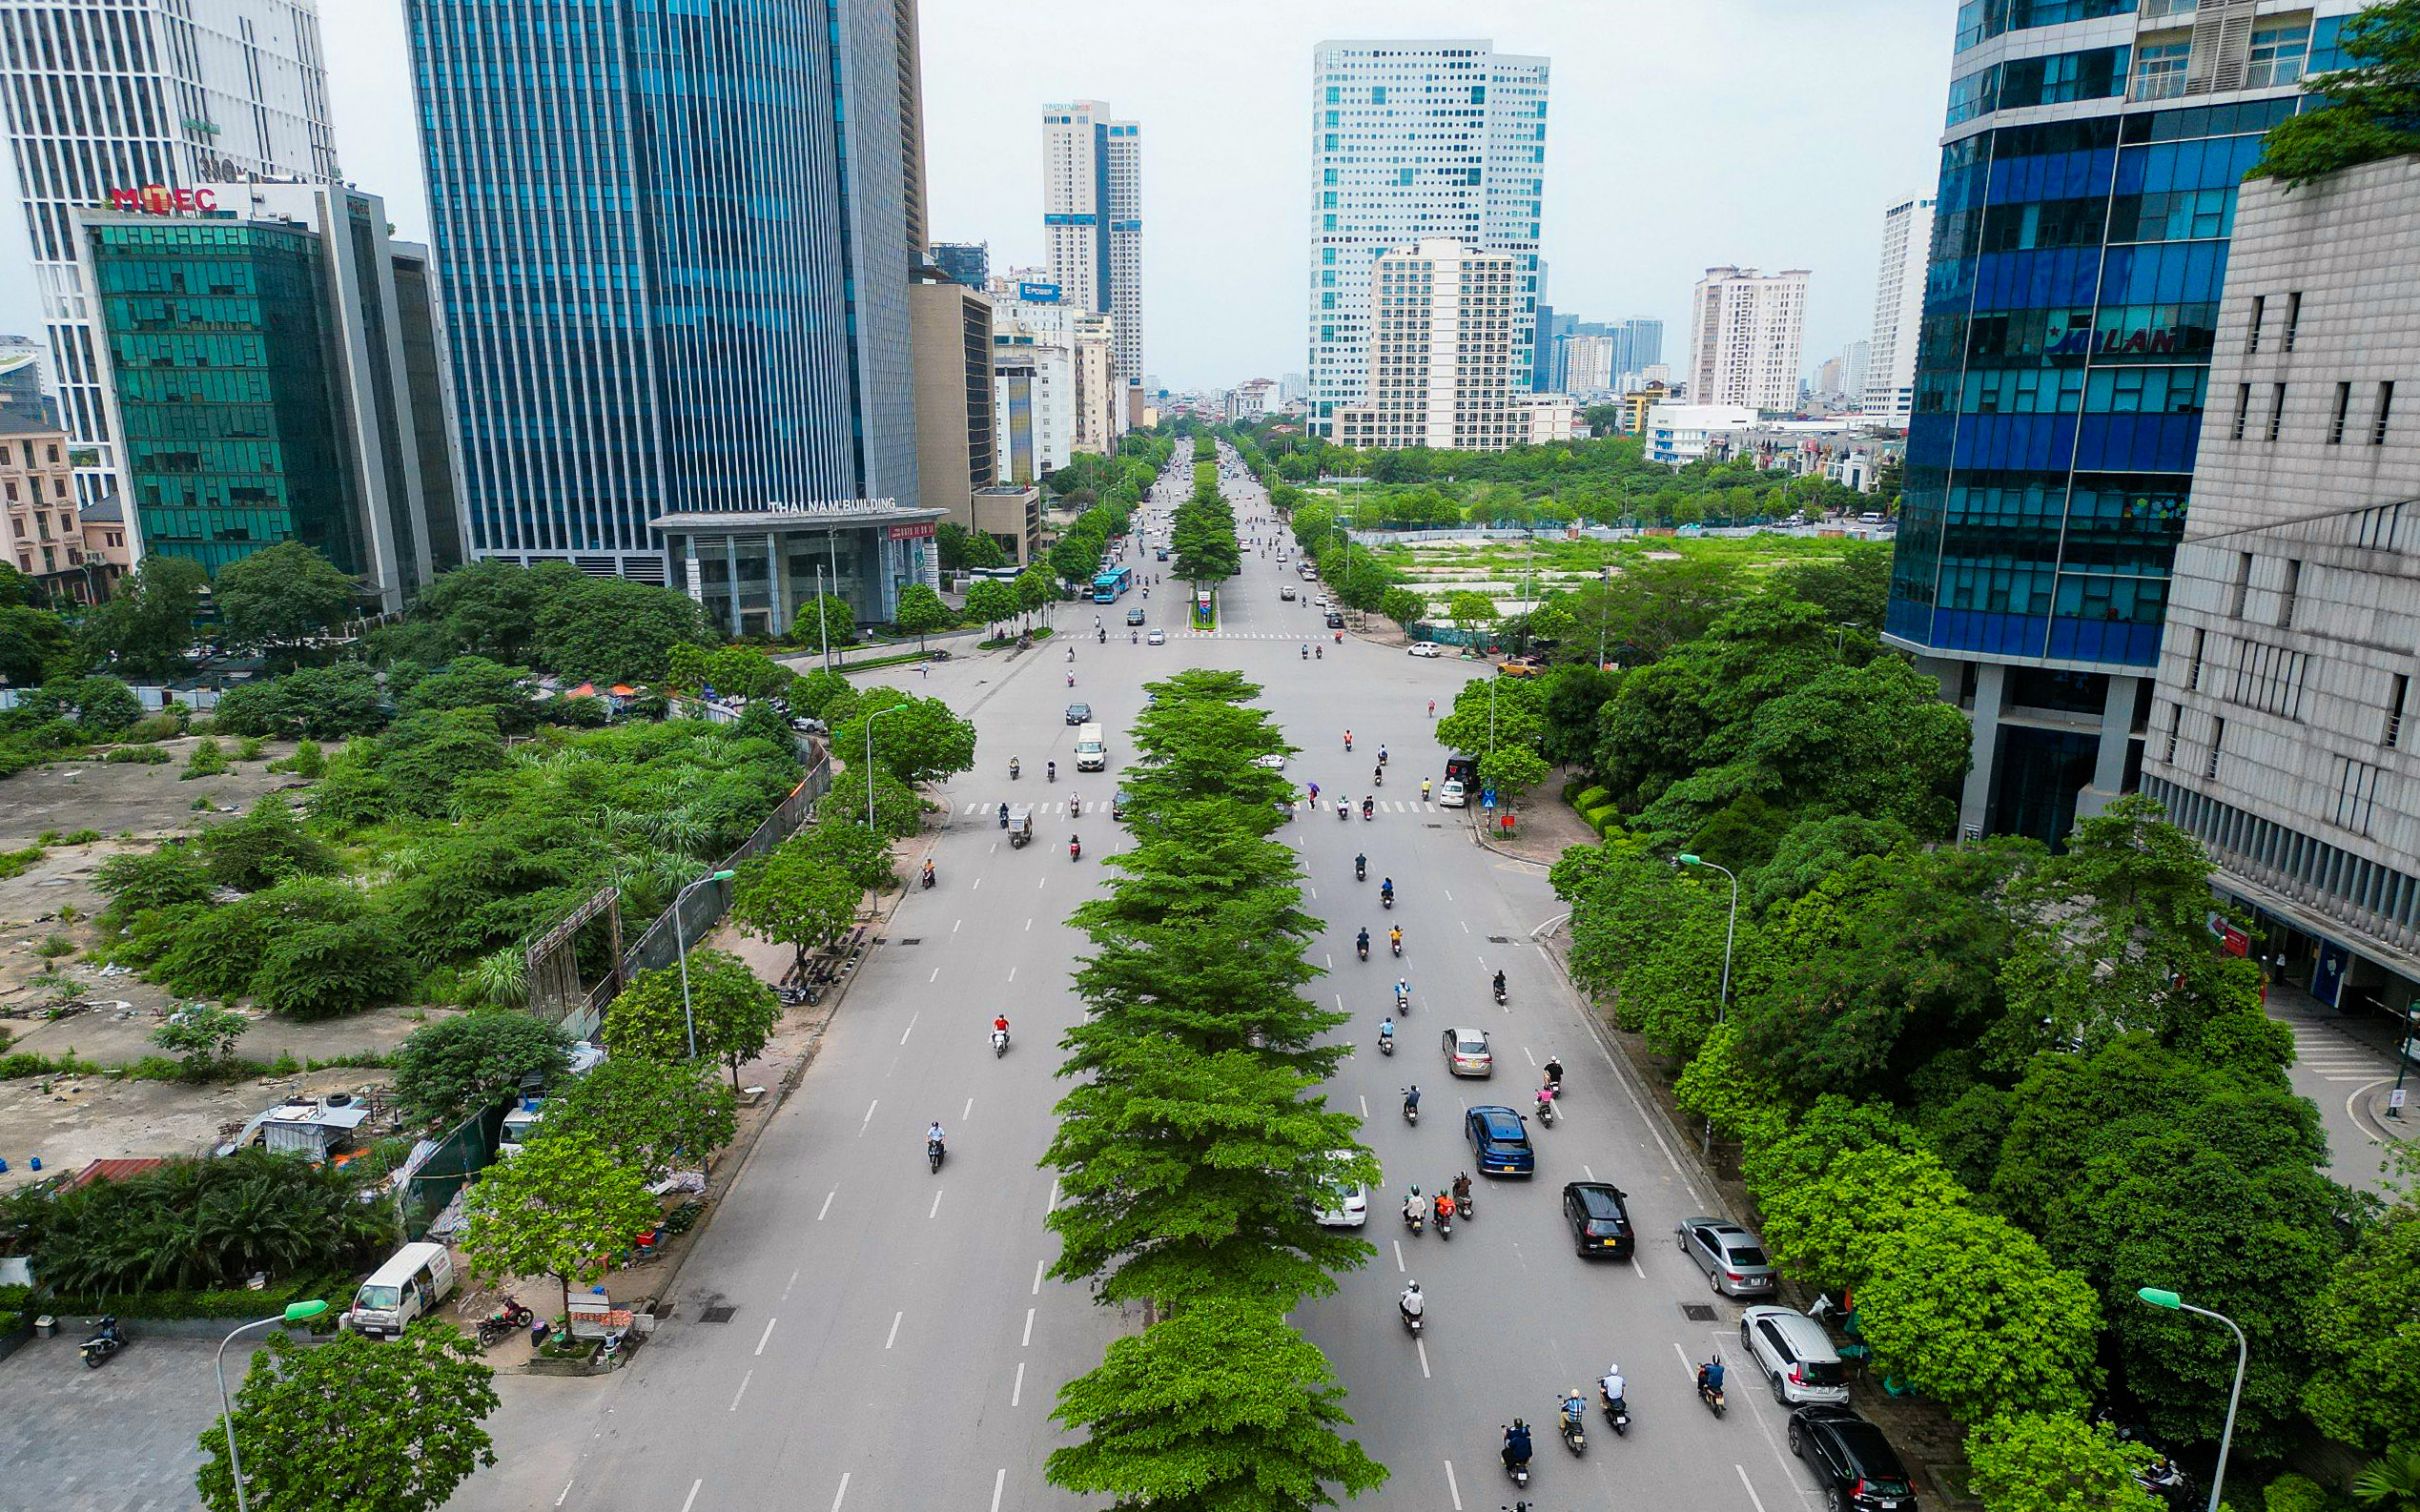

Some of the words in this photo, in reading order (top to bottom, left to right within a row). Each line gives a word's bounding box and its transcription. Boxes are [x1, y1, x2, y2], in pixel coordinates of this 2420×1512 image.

[768, 501, 805, 515] THAI
[807, 500, 839, 513] NAM
[842, 497, 896, 513] BUILDING
